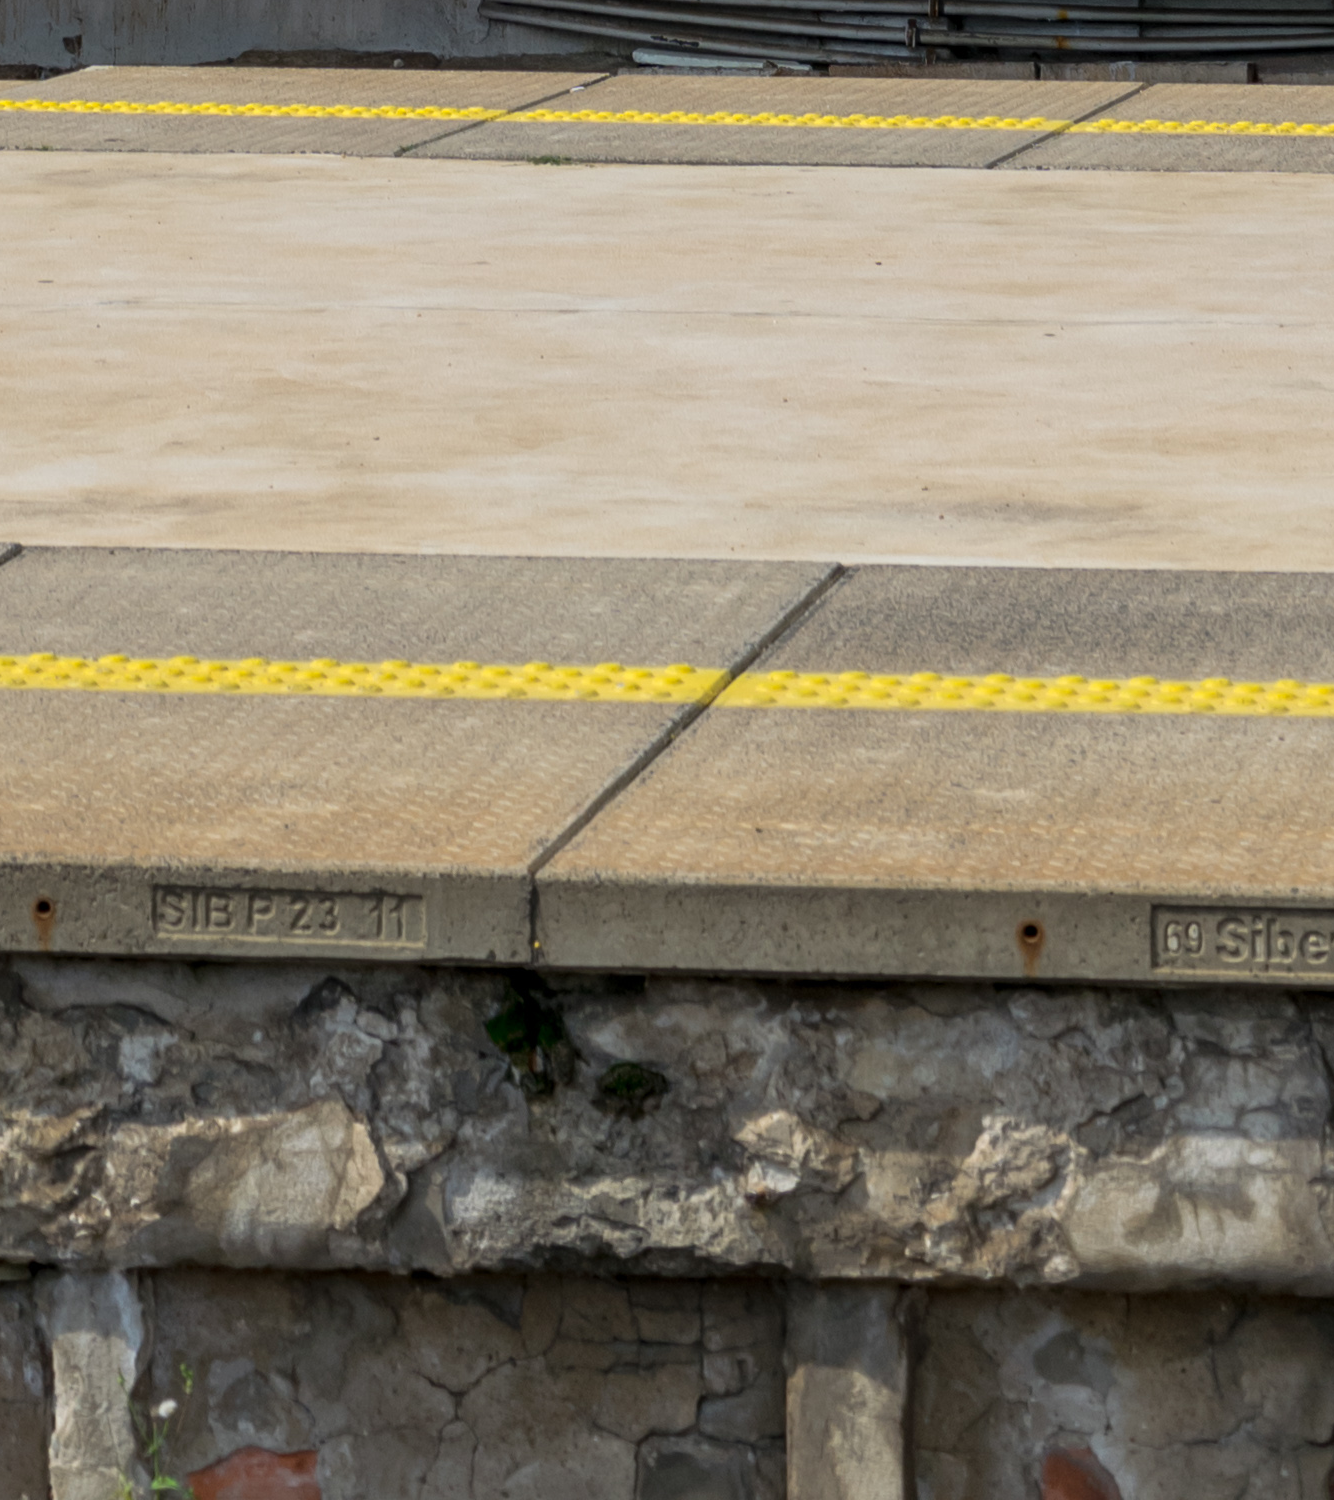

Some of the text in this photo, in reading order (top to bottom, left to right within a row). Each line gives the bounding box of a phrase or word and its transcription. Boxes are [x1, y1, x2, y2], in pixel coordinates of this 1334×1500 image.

[247, 894, 275, 935] P
[288, 896, 341, 936] 23
[368, 896, 407, 941] 11
[1166, 920, 1205, 958] 69
